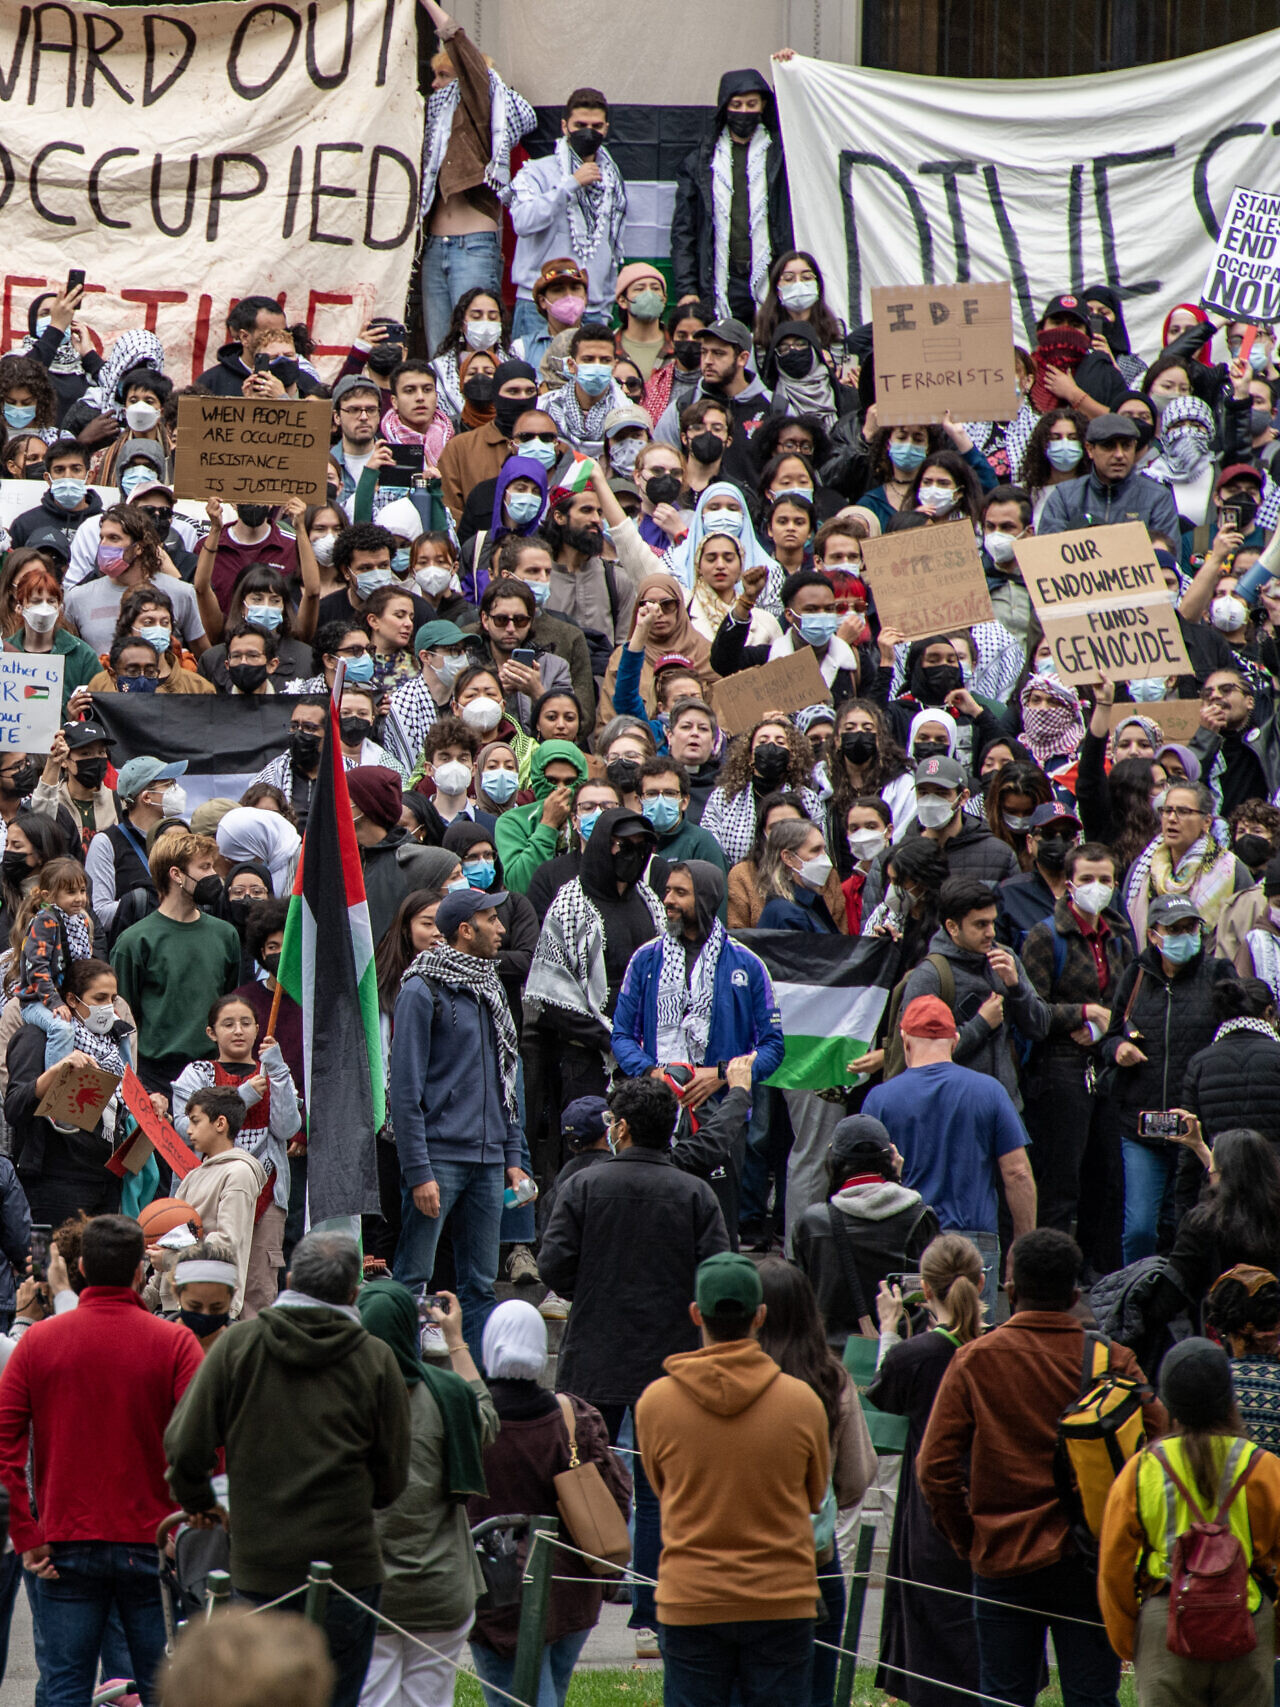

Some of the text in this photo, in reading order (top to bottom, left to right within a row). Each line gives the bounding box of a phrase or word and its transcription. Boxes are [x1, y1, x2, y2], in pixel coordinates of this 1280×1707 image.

[1224, 226, 1277, 259] END
[887, 300, 979, 332] IDF
[879, 368, 1004, 392] TERRORISTS
[202, 406, 307, 428] WHEN PEOPLE
[202, 428, 315, 448] ARE OCCUPIED
[200, 452, 289, 470] RESISTANCE
[204, 478, 317, 494] IS JUSTIFIED
[1061, 539, 1102, 564] OUR
[1036, 563, 1155, 603] ENDOWMENT
[1087, 606, 1149, 632] FUNDS
[1055, 628, 1180, 673] GENOCIDE
